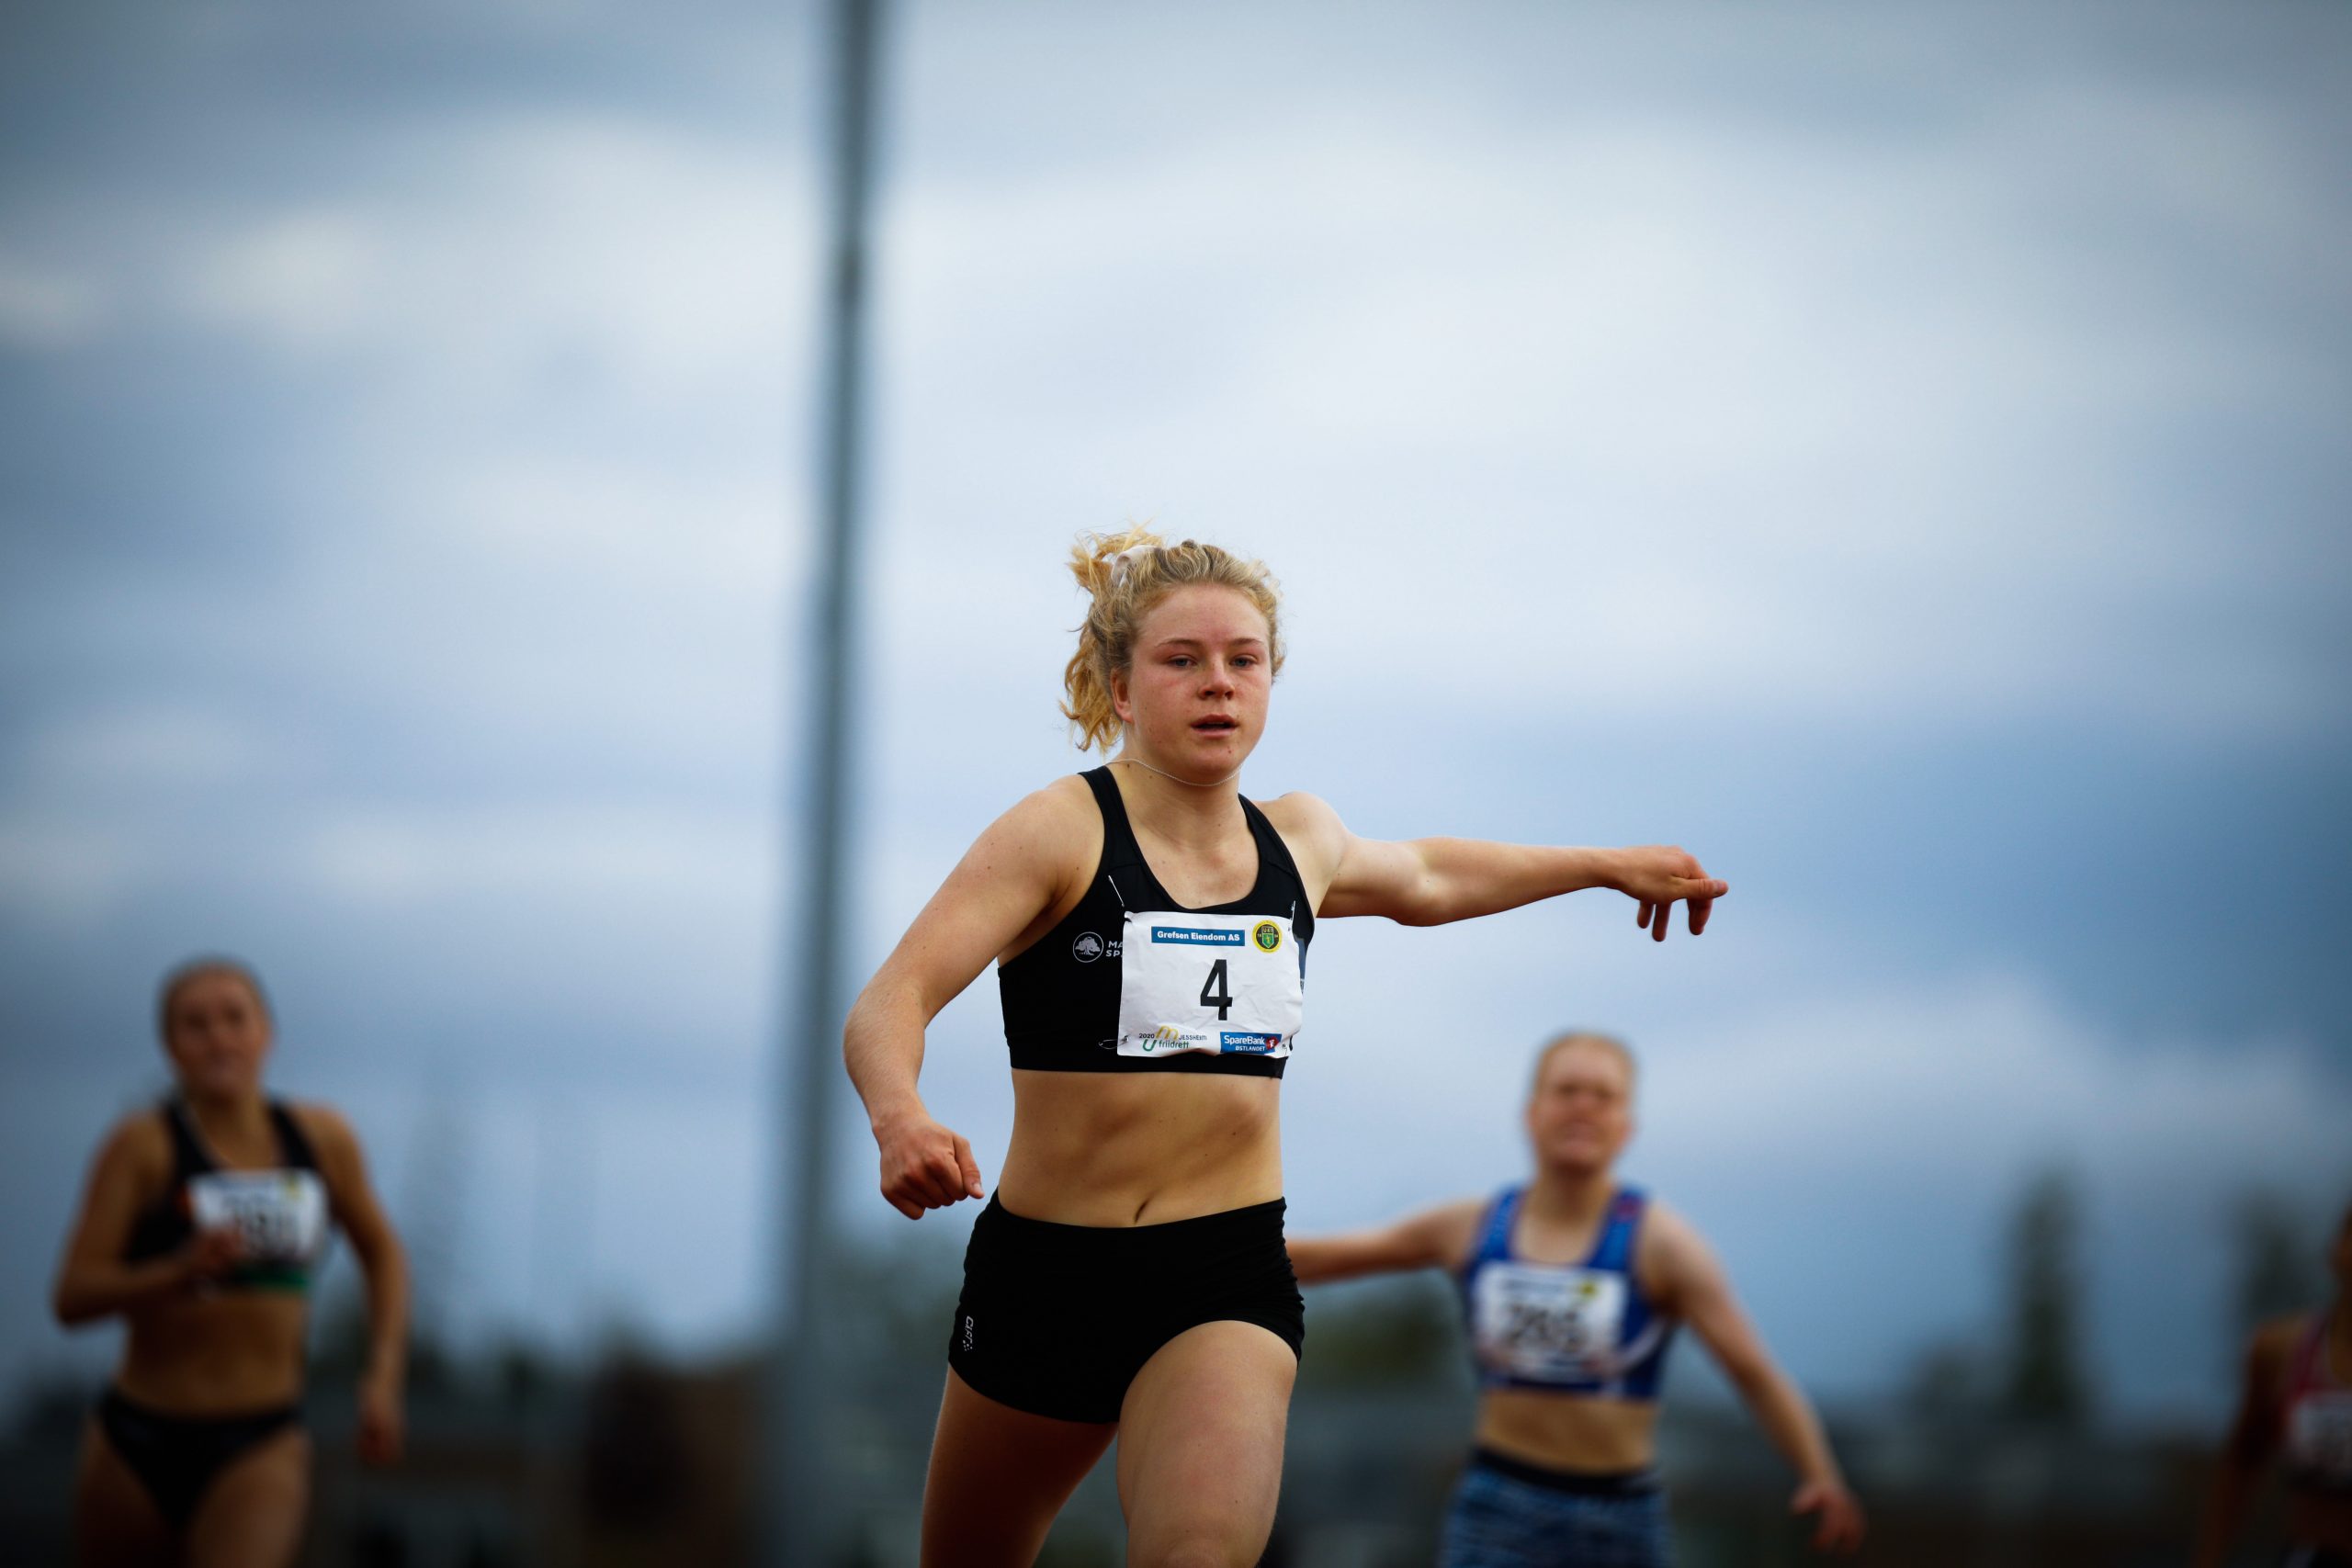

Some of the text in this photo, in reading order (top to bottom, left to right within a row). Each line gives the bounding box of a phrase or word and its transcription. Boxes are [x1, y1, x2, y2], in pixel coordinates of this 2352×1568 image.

[1158, 931, 1240, 942] Grefsen Eiendom AS
[1200, 959, 1233, 1021] 4
[1159, 1040, 1190, 1049] friidrett
[1224, 1034, 1265, 1045] SpareBank
